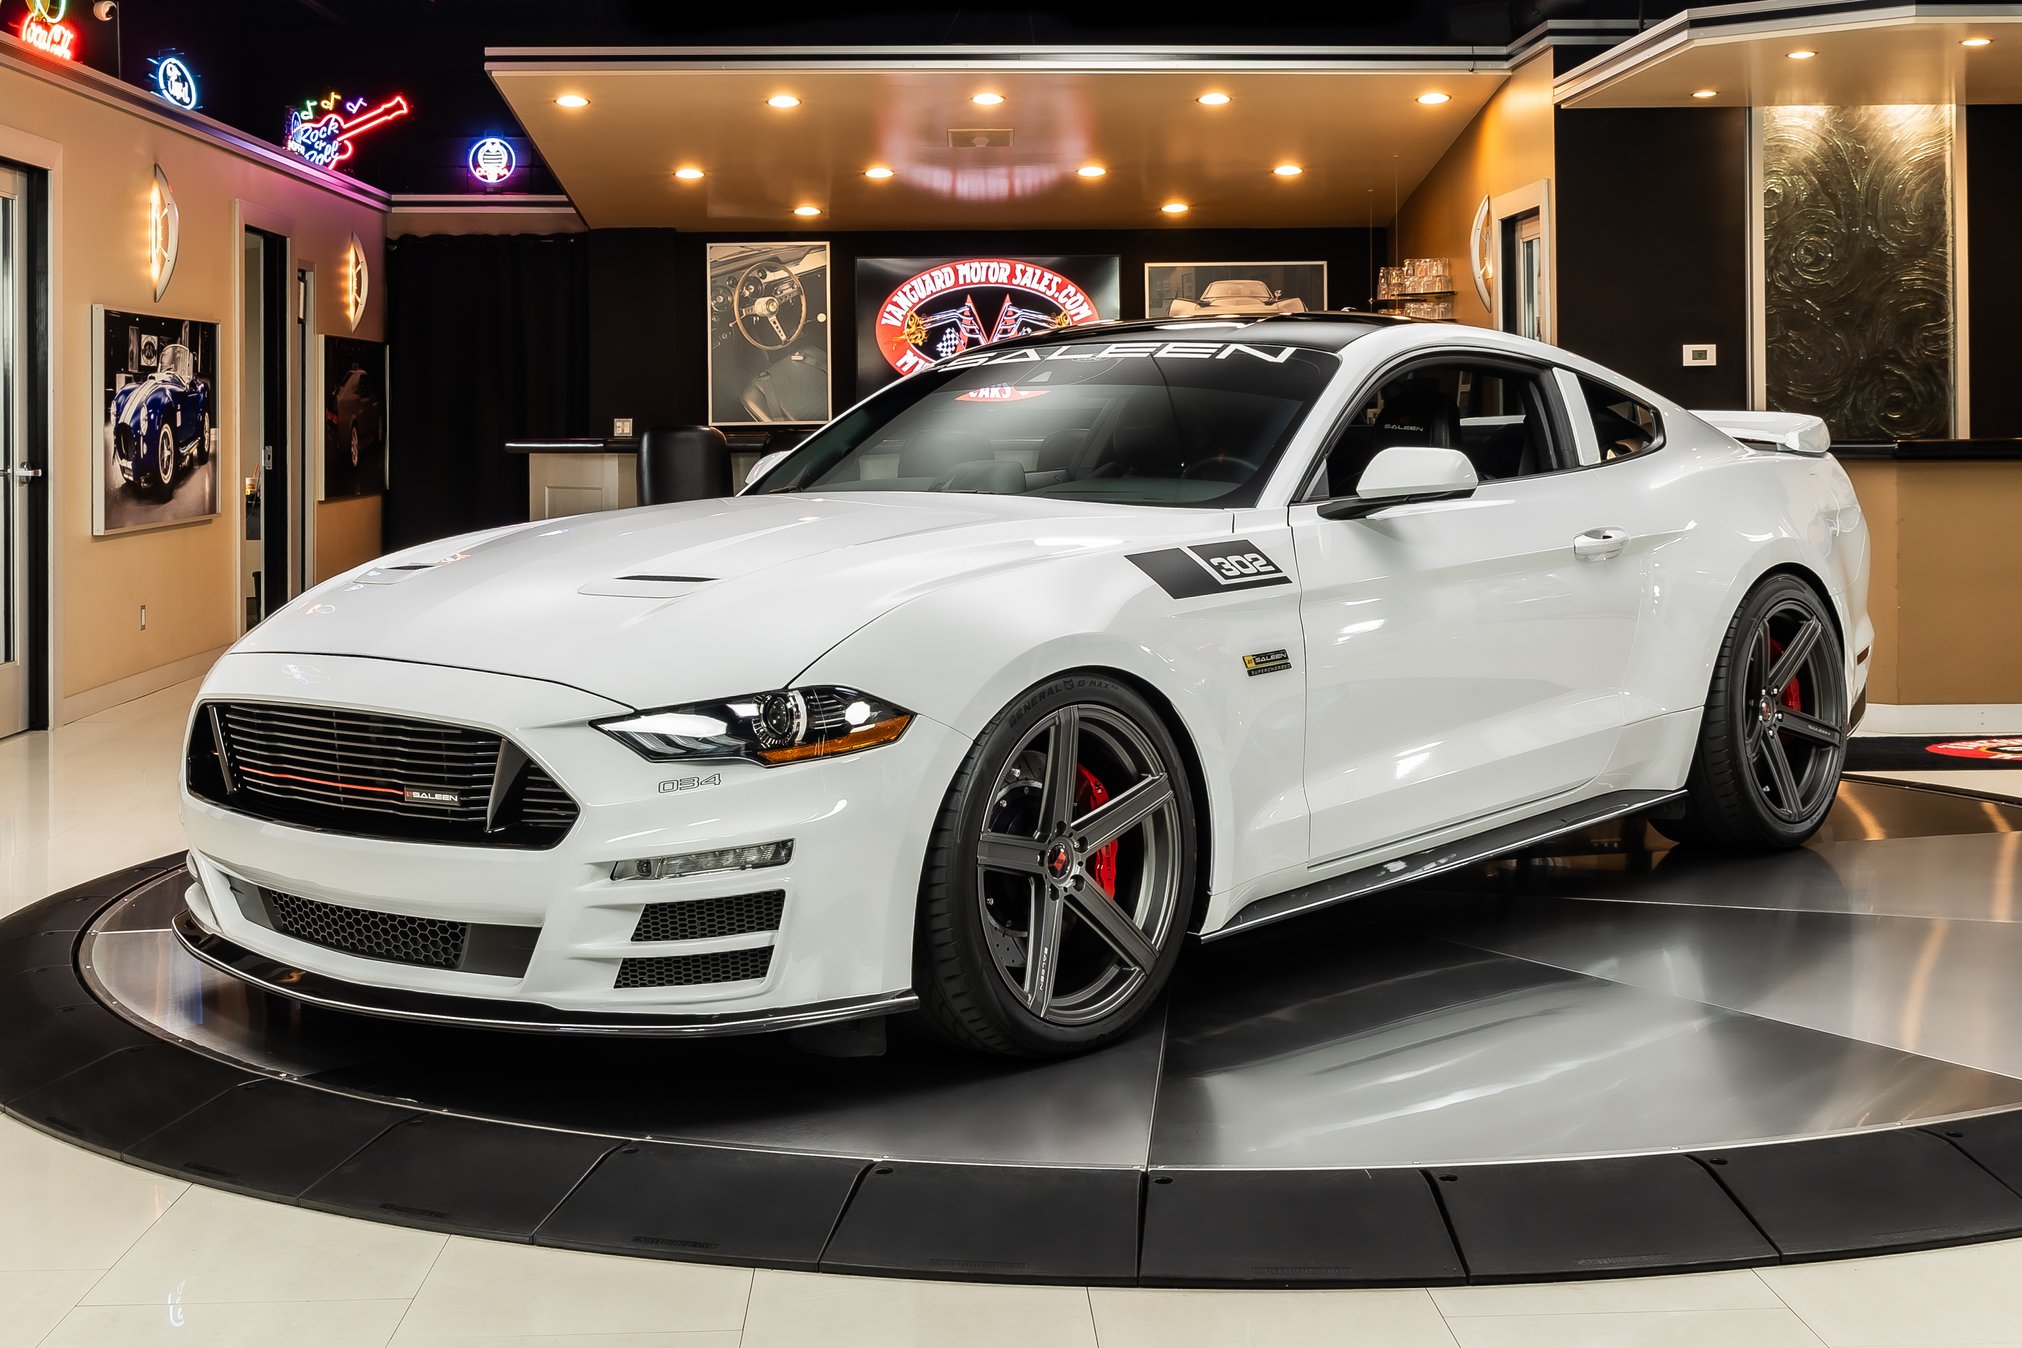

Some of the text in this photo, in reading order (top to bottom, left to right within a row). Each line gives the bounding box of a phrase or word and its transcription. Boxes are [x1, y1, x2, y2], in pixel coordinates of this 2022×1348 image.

[300, 117, 340, 145] Rock
[881, 261, 1093, 328] VANGUARD MOTOR SALES.COM
[938, 343, 1298, 372] SALEEN
[1384, 423, 1424, 432] SALEEN
[1209, 553, 1276, 577] 302
[1255, 652, 1287, 663] SALEEN
[1008, 684, 1063, 728] GENERAL
[658, 773, 721, 793] 034
[412, 791, 458, 802] SALEEN
